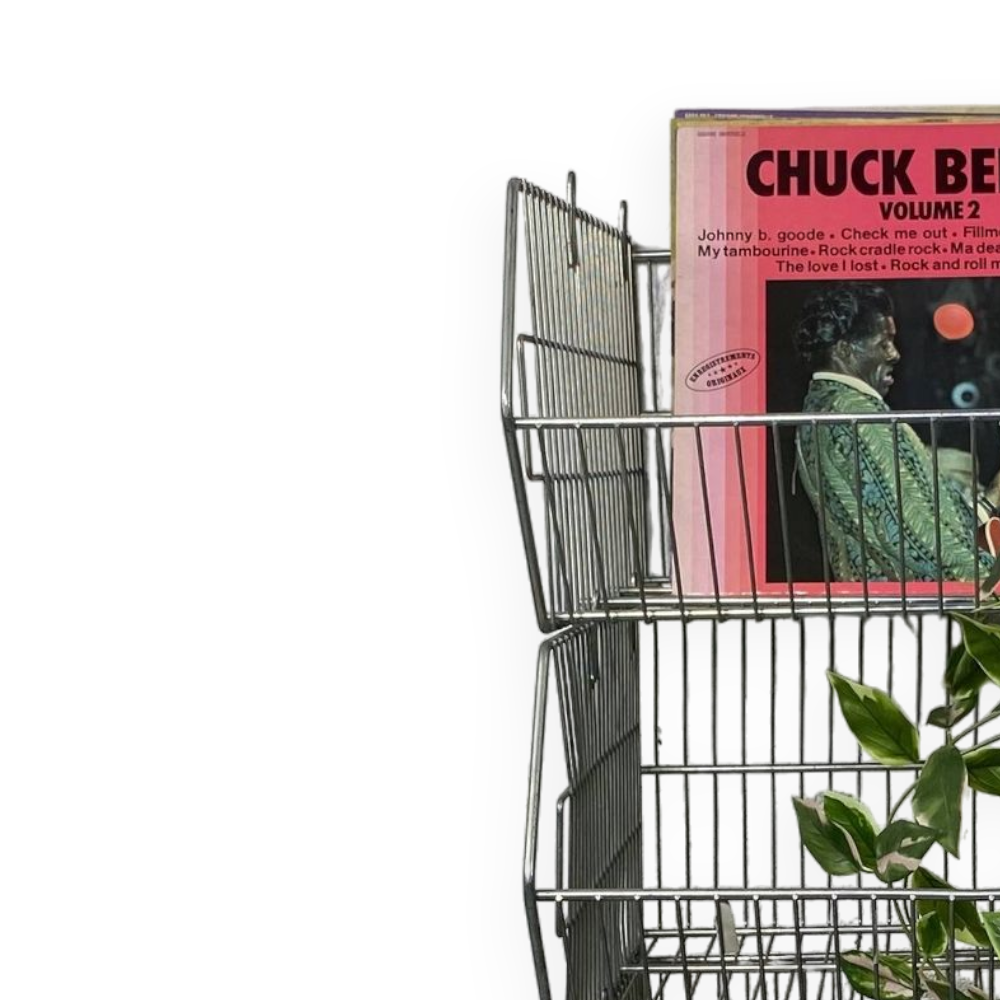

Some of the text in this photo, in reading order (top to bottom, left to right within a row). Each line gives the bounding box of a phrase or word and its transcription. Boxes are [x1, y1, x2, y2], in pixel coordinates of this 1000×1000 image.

[746, 149, 917, 196] CHUCK
[879, 200, 980, 220] VOLUME 2
[698, 229, 752, 243] Johnny
[758, 229, 772, 241] b.
[778, 229, 825, 244] goode
[841, 228, 888, 240] Check
[895, 229, 917, 239] me
[923, 227, 947, 239] out
[698, 245, 720, 259] My
[723, 244, 808, 257] tambourine
[819, 244, 857, 256] Rock
[860, 244, 906, 255] cradle
[908, 243, 942, 255] rock
[950, 243, 973, 254] Ma
[776, 260, 804, 273] The
[808, 260, 838, 272] love
[851, 259, 878, 271] lost
[891, 258, 929, 271] Rock
[932, 258, 960, 270] and
[964, 257, 987, 270] roll
[706, 366, 747, 387] ORIGINAUX
